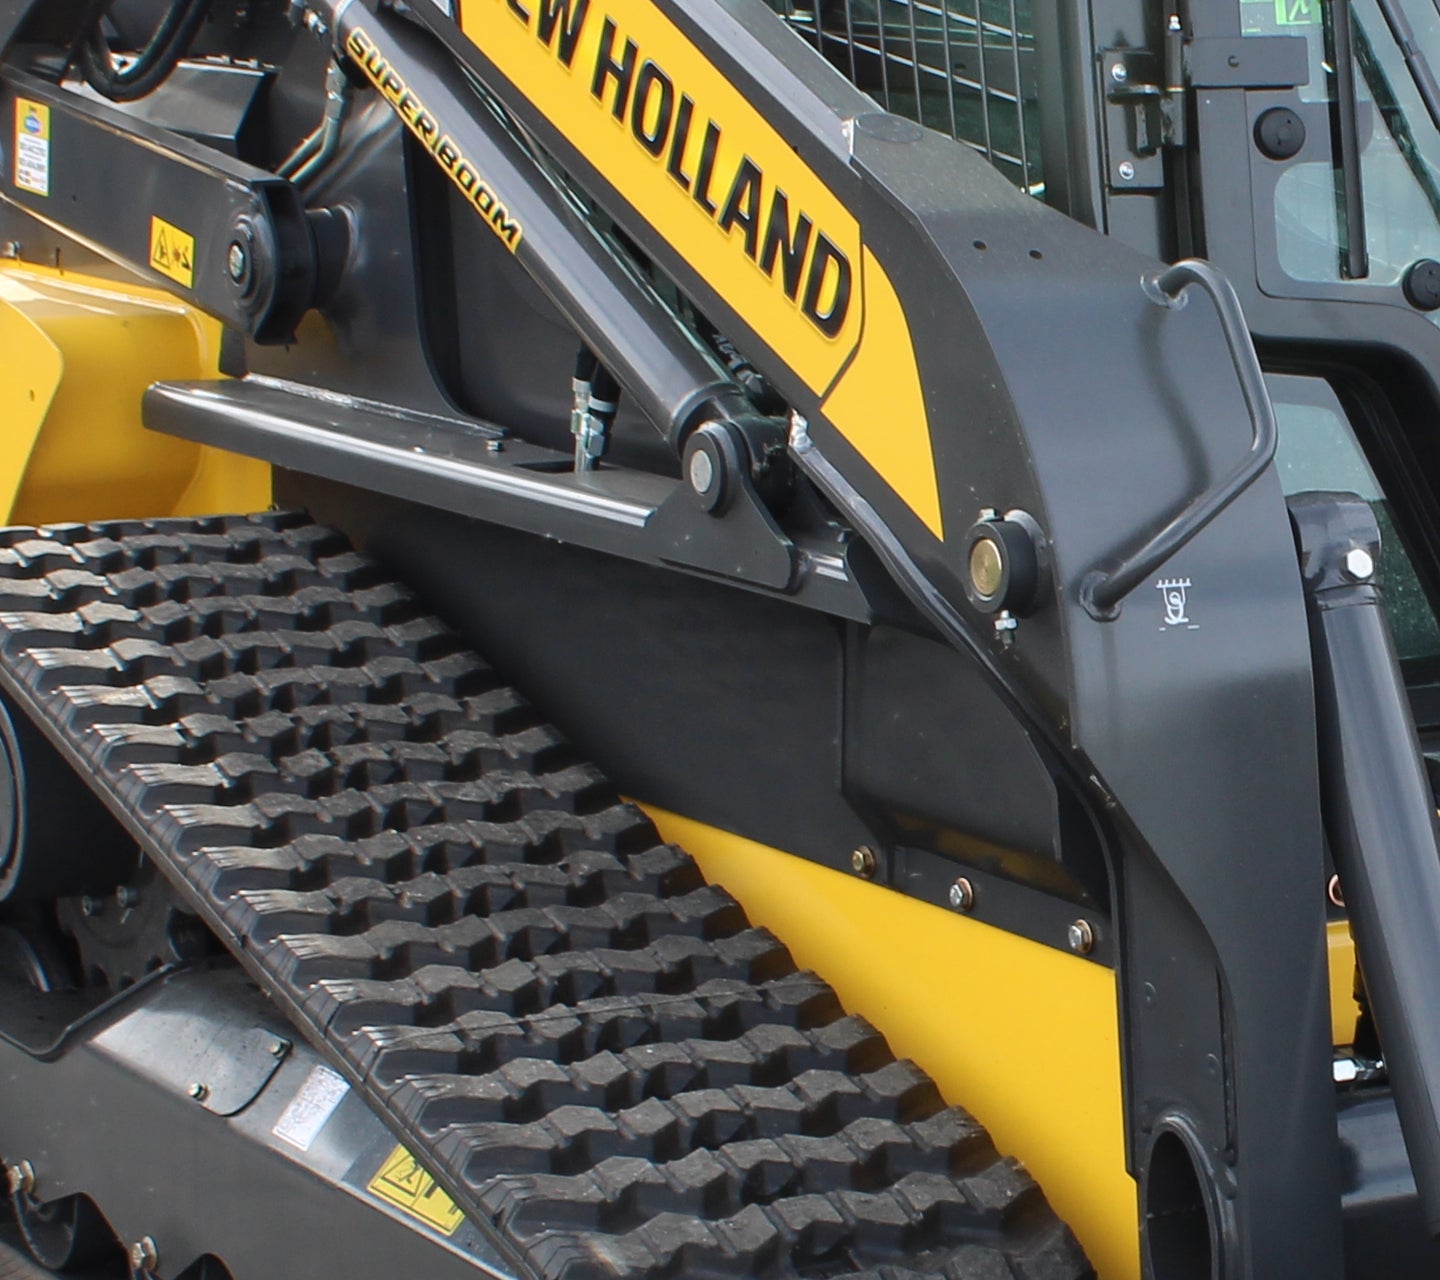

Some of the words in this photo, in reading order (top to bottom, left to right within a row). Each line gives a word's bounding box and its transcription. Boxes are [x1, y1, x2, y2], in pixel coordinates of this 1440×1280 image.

[346, 27, 439, 150] SUPER
[435, 134, 523, 254] BOOM
[590, 14, 853, 340] HOLLAND
